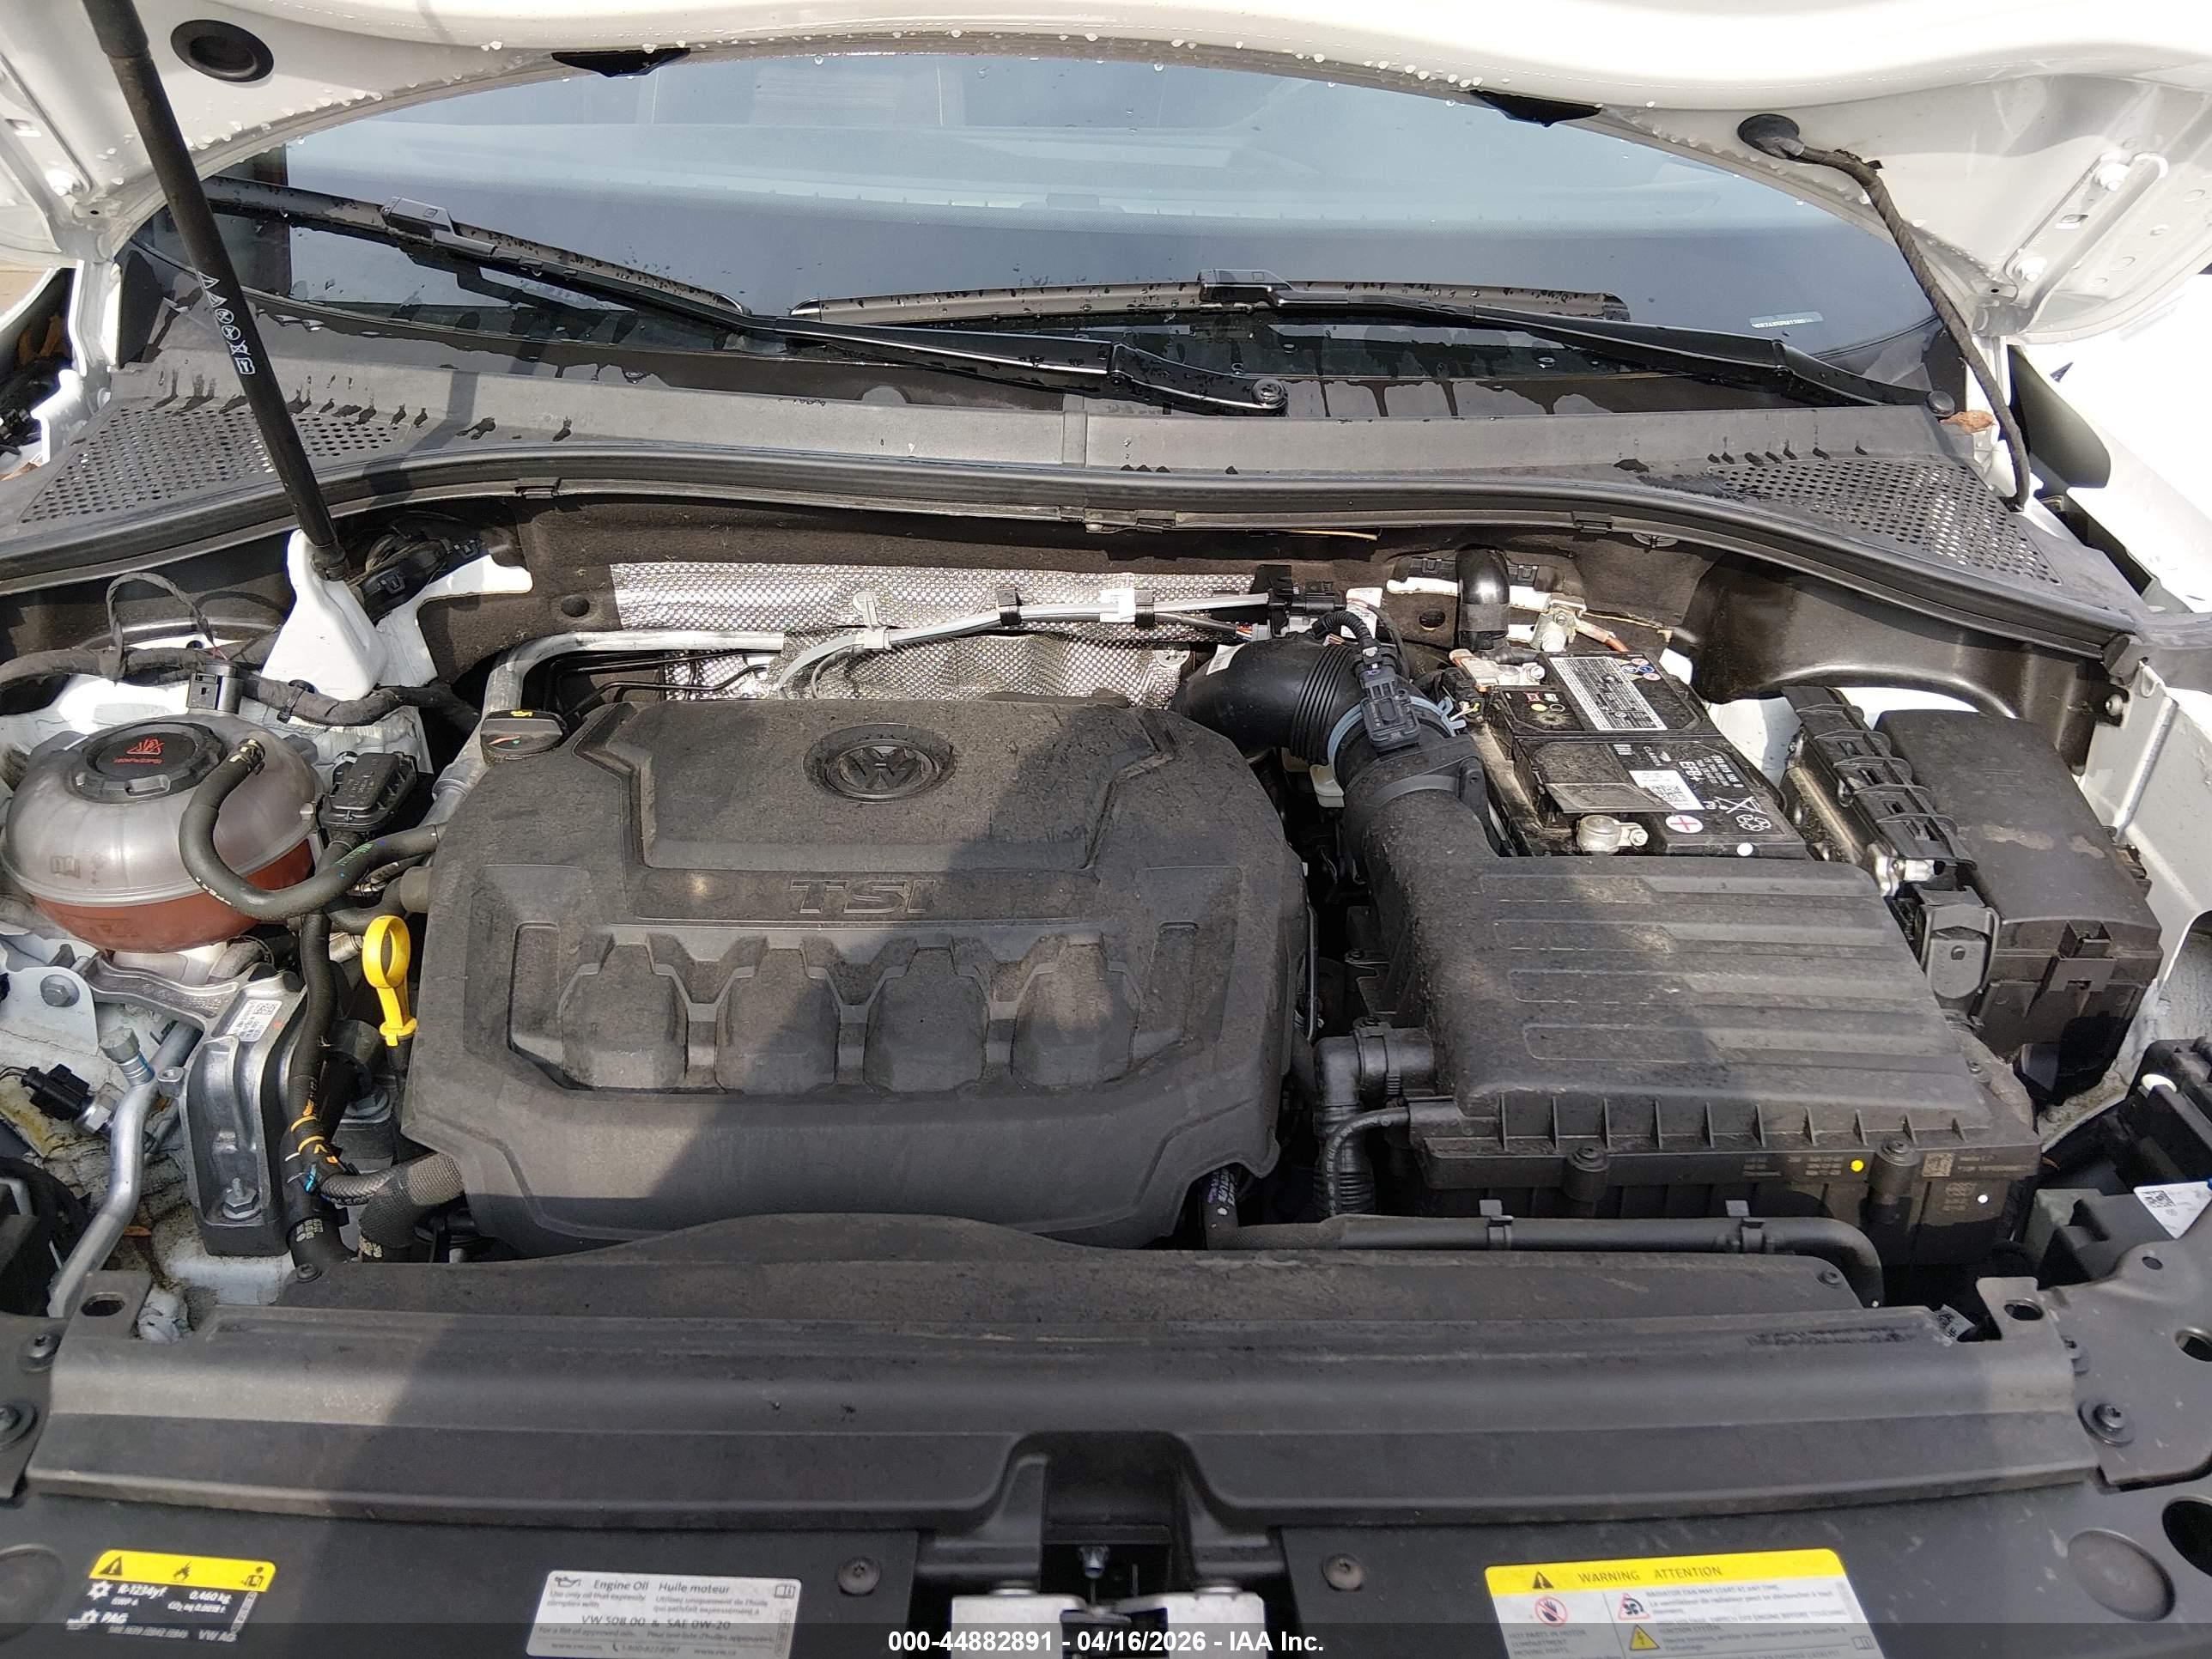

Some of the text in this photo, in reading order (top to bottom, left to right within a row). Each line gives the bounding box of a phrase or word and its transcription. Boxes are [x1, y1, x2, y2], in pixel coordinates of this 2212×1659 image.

[1643, 745, 1663, 767] CLARIOS
[1679, 761, 1705, 782] EFB+
[1702, 800, 1718, 810] Pb
[789, 878, 938, 915] TSI
[1578, 1565, 1723, 1583] WARNING ATTENTION
[117, 1584, 169, 1600] R-1234yf
[593, 1579, 649, 1592] Engine Oil
[659, 1582, 730, 1595] Huile moteur
[100, 1612, 129, 1624] PAG
[581, 1615, 603, 1625] VW
[666, 1619, 687, 1629] SAE
[690, 1620, 732, 1631] 0W-20
[198, 1629, 218, 1641] VW
[217, 1632, 237, 1643] AG
